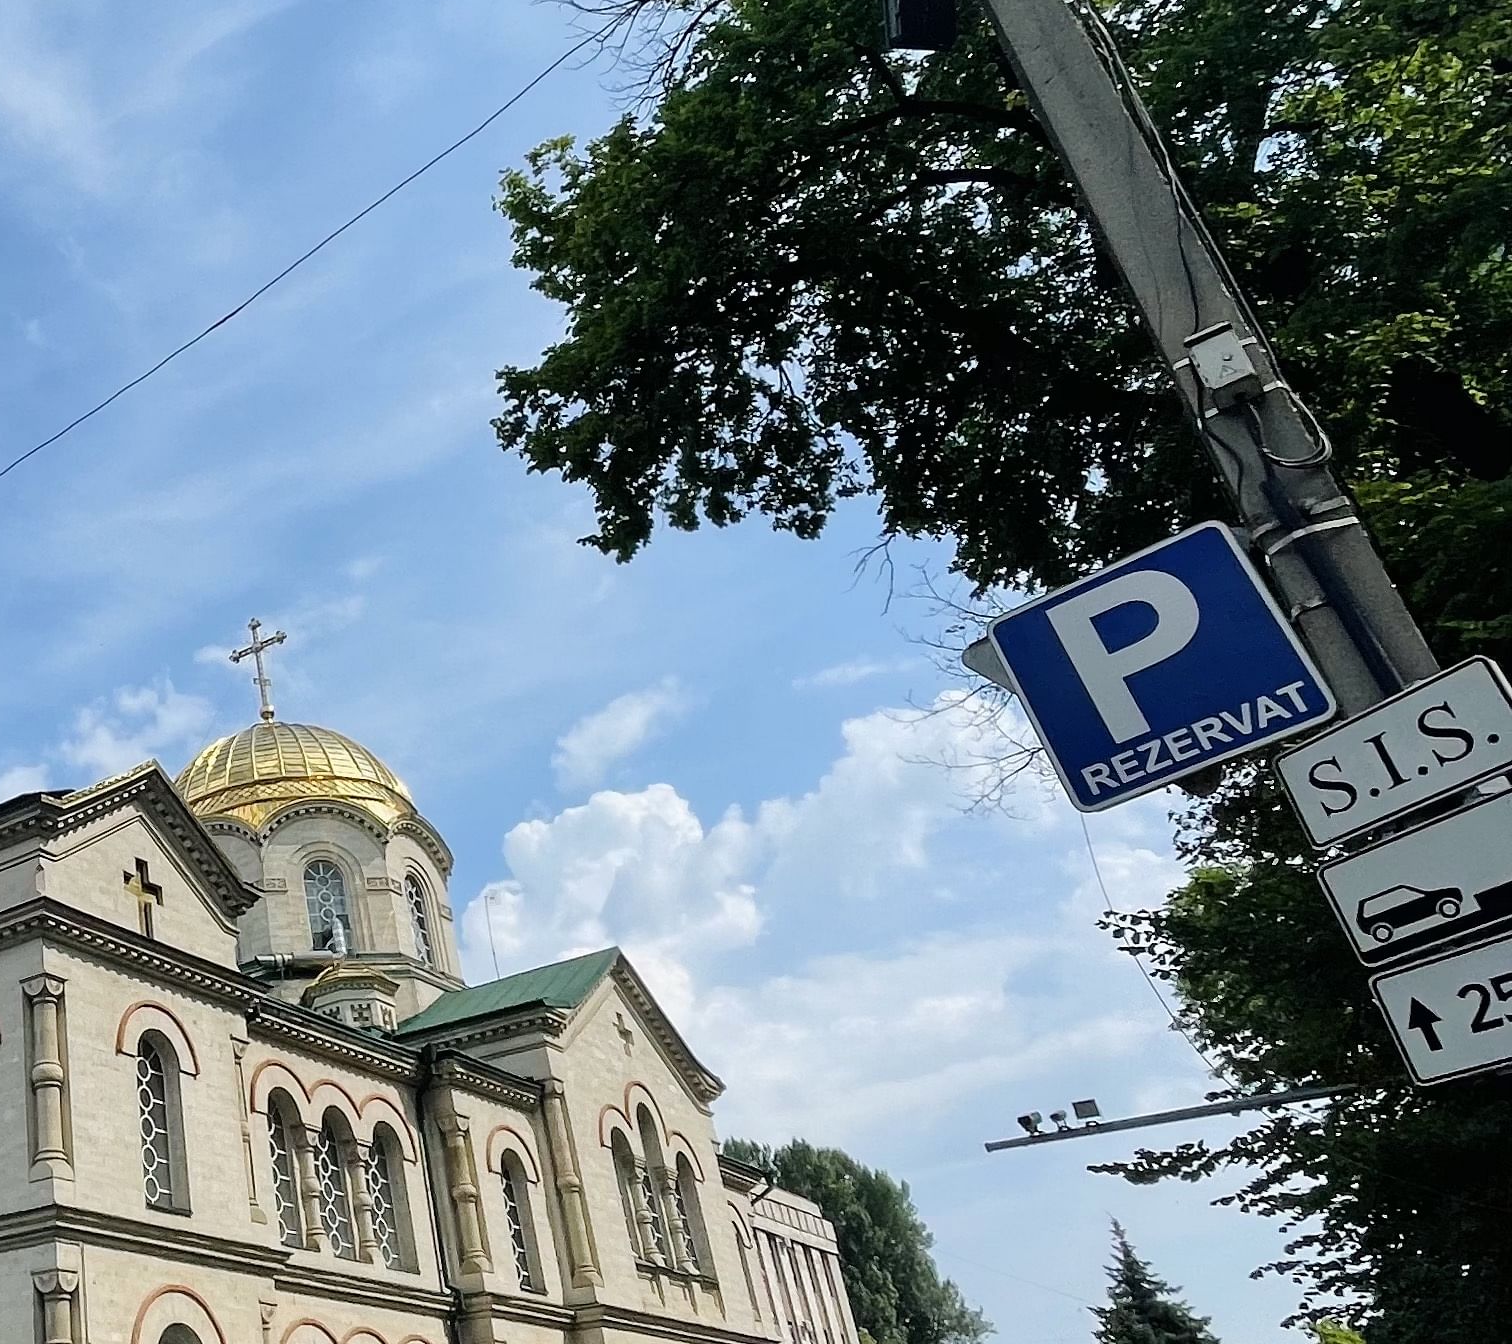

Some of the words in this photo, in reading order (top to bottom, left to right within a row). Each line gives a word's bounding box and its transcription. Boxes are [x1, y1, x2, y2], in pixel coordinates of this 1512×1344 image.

[1045, 569, 1200, 744] P
[1081, 680, 1309, 796] REZERVAT
[1308, 701, 1500, 818] S.I.S.
